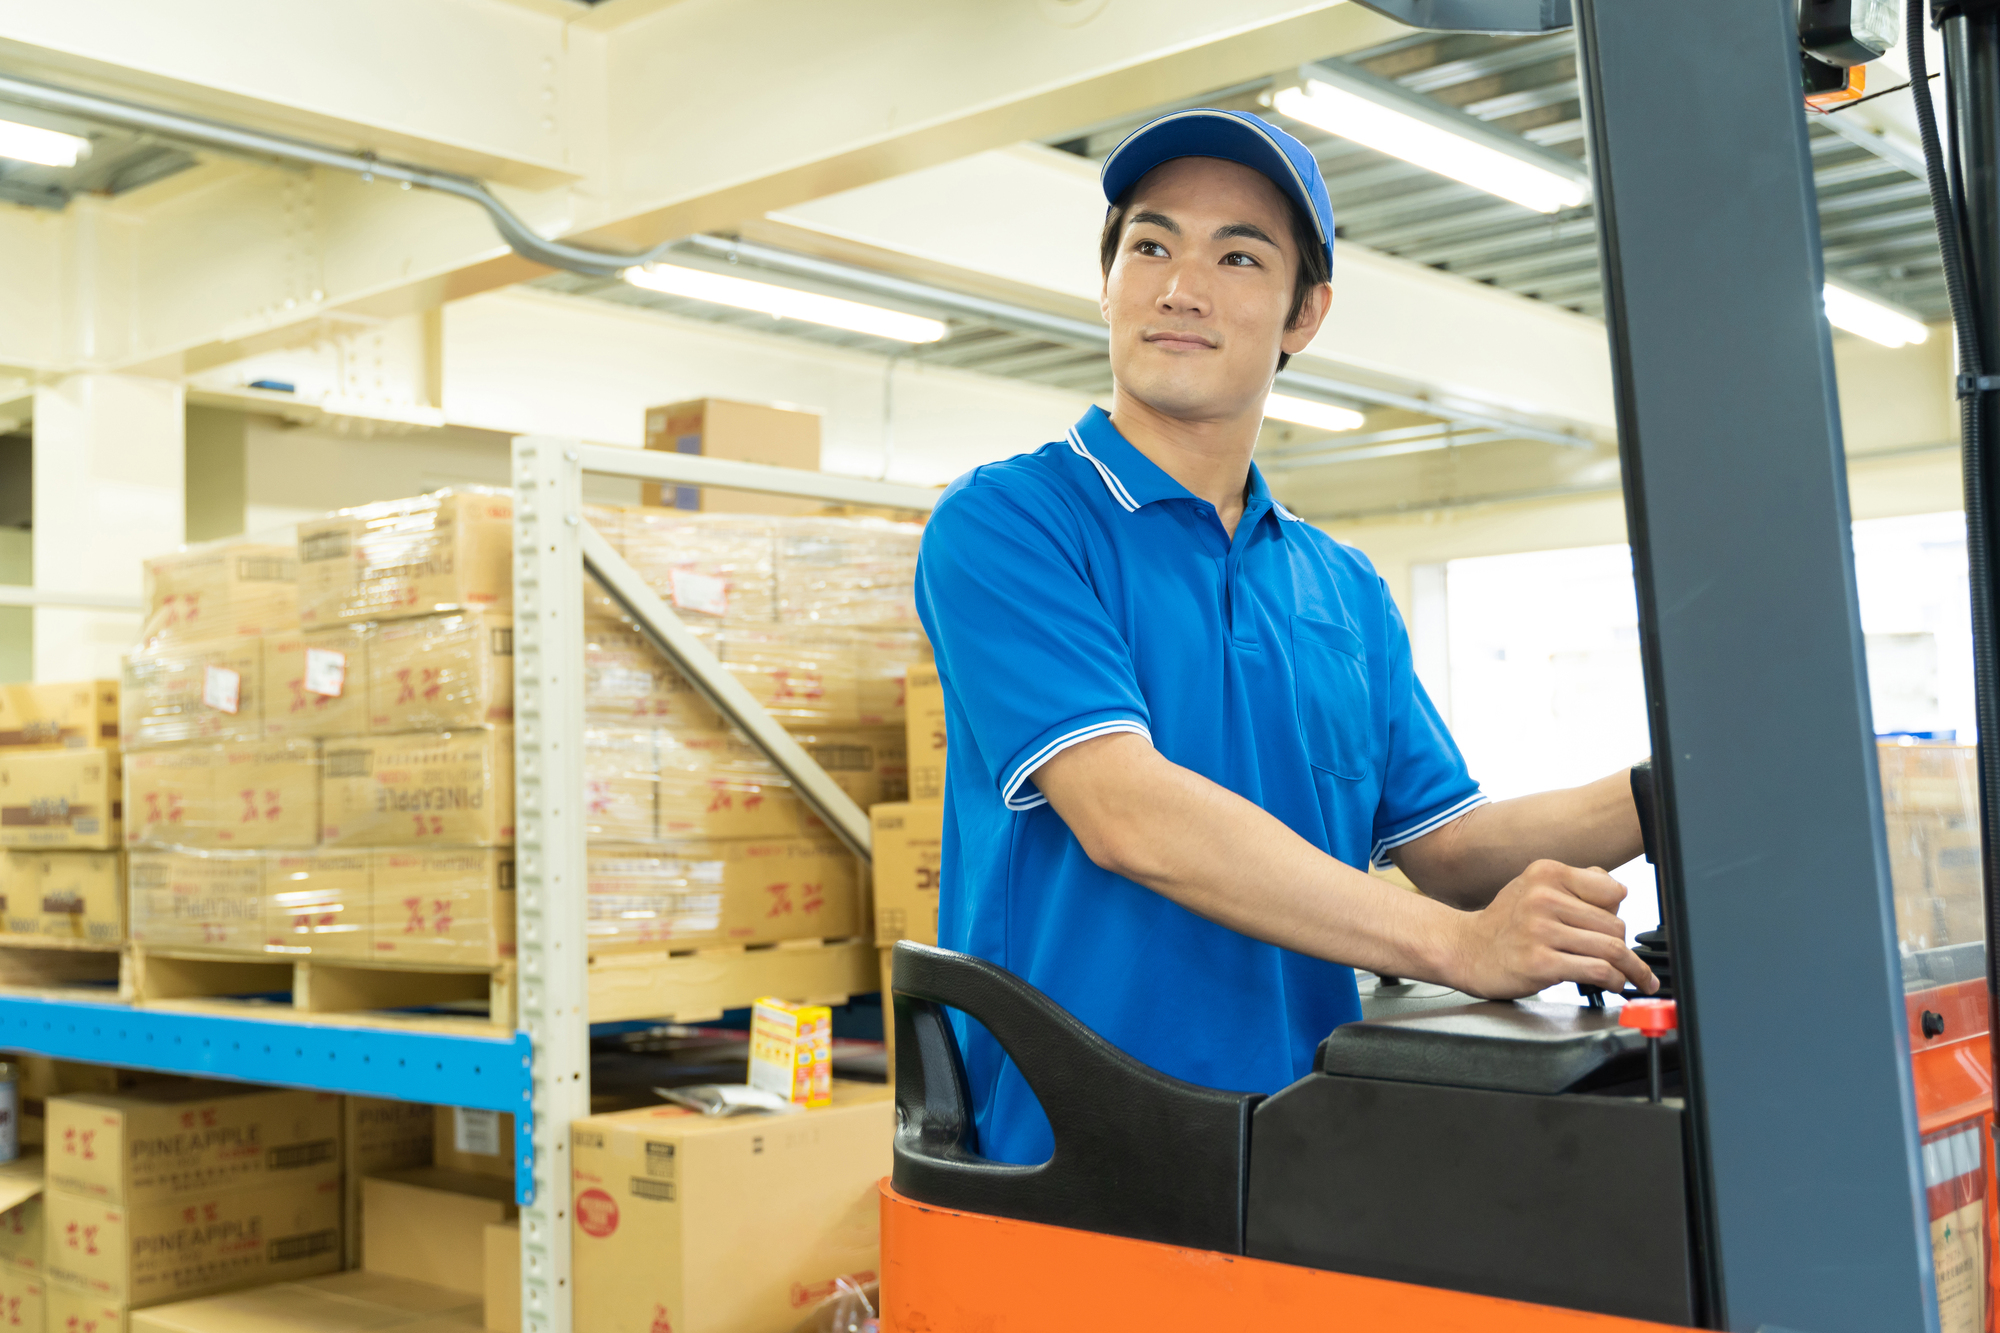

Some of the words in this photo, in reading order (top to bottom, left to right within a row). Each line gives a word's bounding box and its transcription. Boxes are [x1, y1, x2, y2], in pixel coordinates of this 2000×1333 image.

[376, 786, 483, 812] PINEAPPLE
[129, 1122, 262, 1159] PINEAPPLE
[131, 1215, 263, 1256] PINEAPPLE
